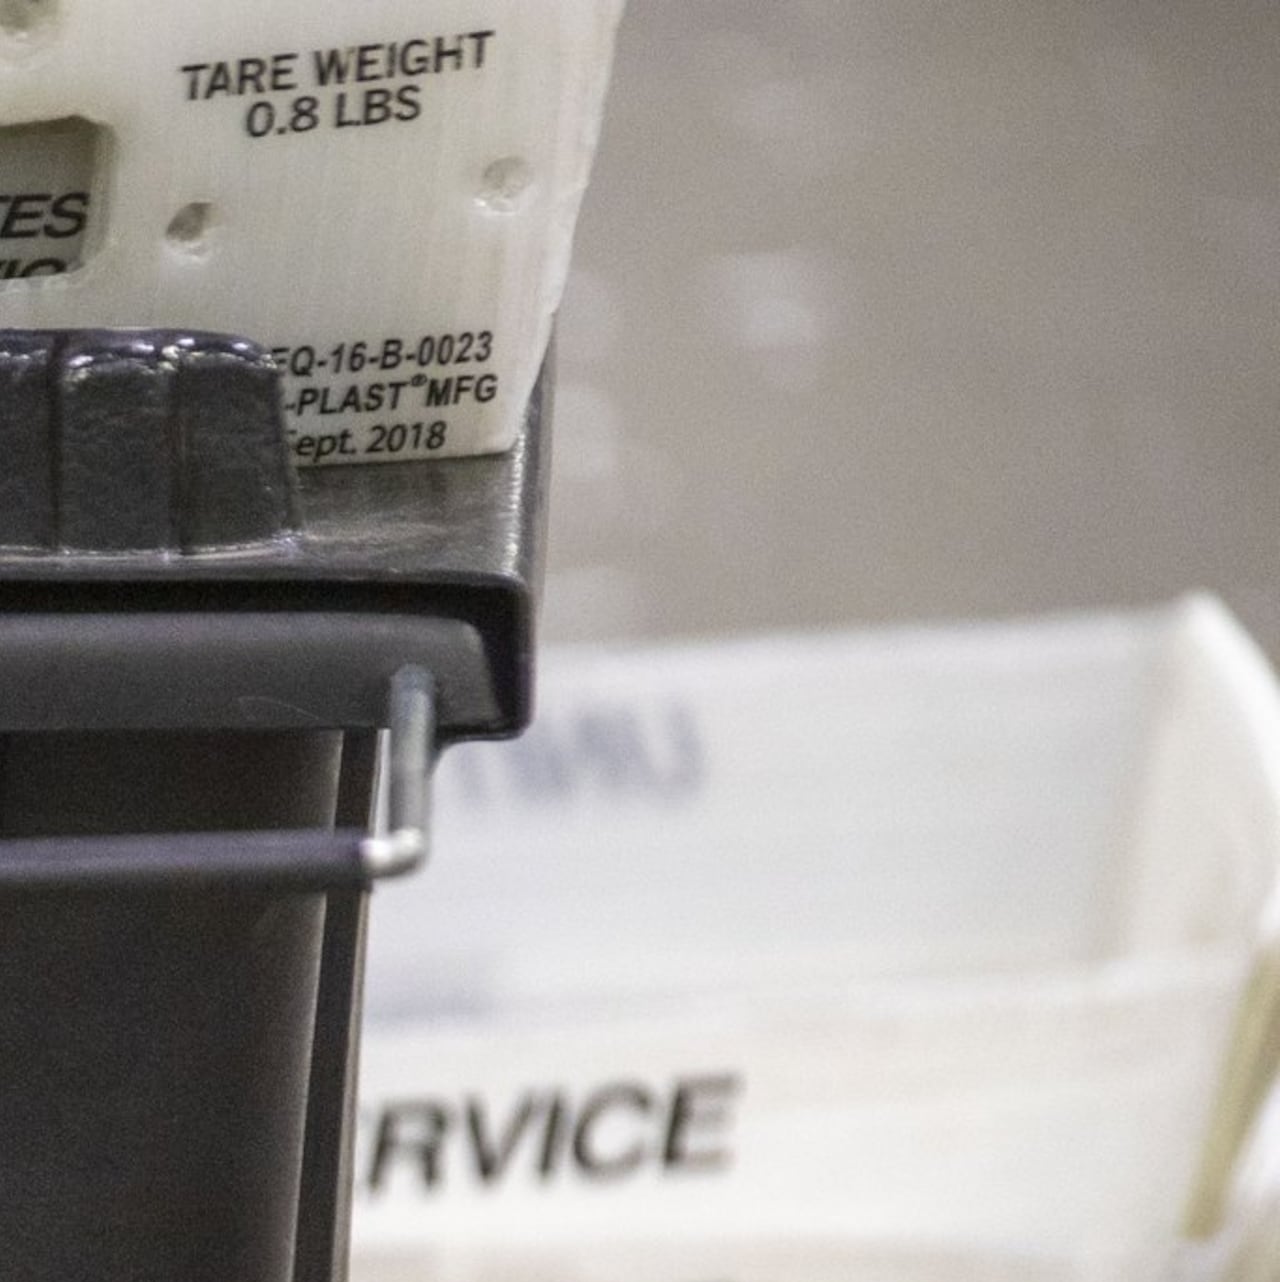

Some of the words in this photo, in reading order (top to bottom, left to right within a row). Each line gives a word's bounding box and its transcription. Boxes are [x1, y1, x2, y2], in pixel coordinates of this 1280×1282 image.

[180, 53, 299, 101] TARE
[313, 30, 496, 87] WEIGHT
[245, 95, 320, 138] 0.8
[334, 84, 422, 128] LBS
[289, 427, 358, 463] ept.
[365, 420, 448, 454] 2018
